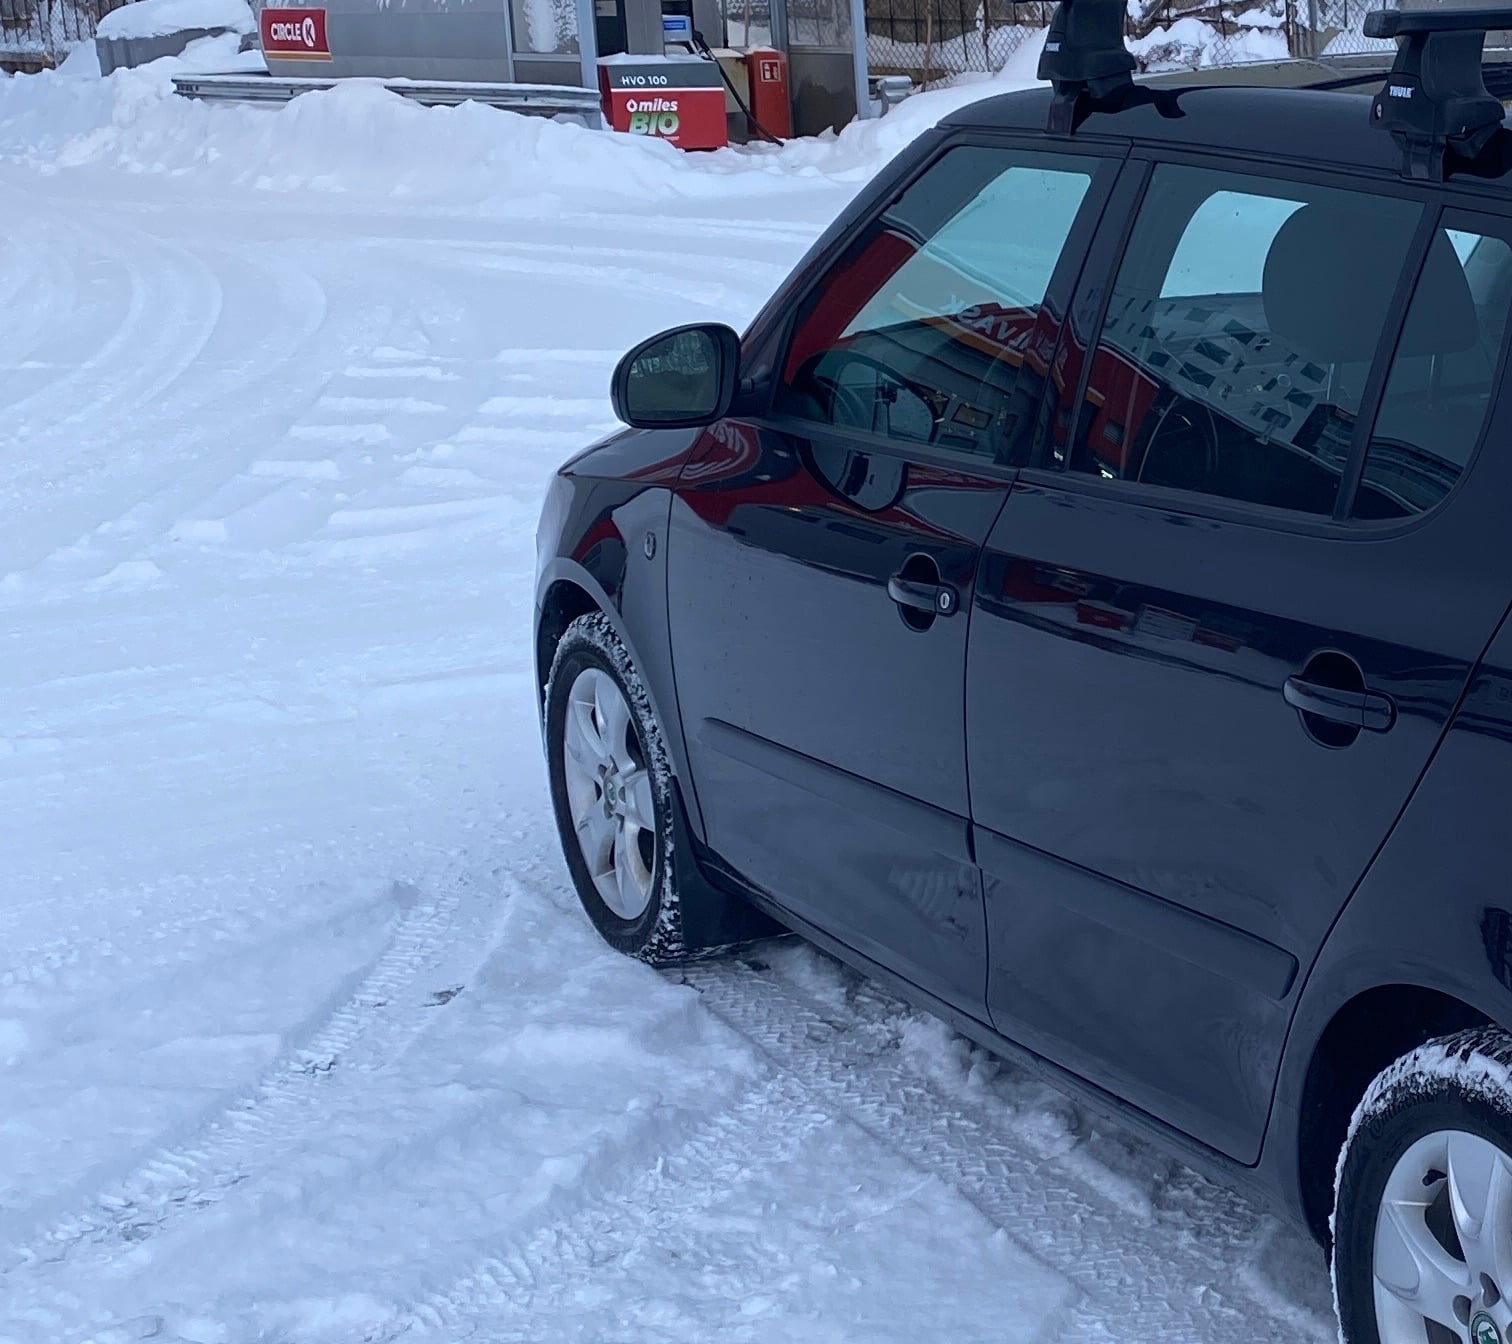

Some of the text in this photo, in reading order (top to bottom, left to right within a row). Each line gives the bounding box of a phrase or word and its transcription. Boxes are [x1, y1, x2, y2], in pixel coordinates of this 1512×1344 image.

[271, 18, 315, 46] CIRCLE K
[621, 75, 667, 85] HVO 100
[637, 98, 678, 112] miles
[629, 111, 680, 135] BIO
